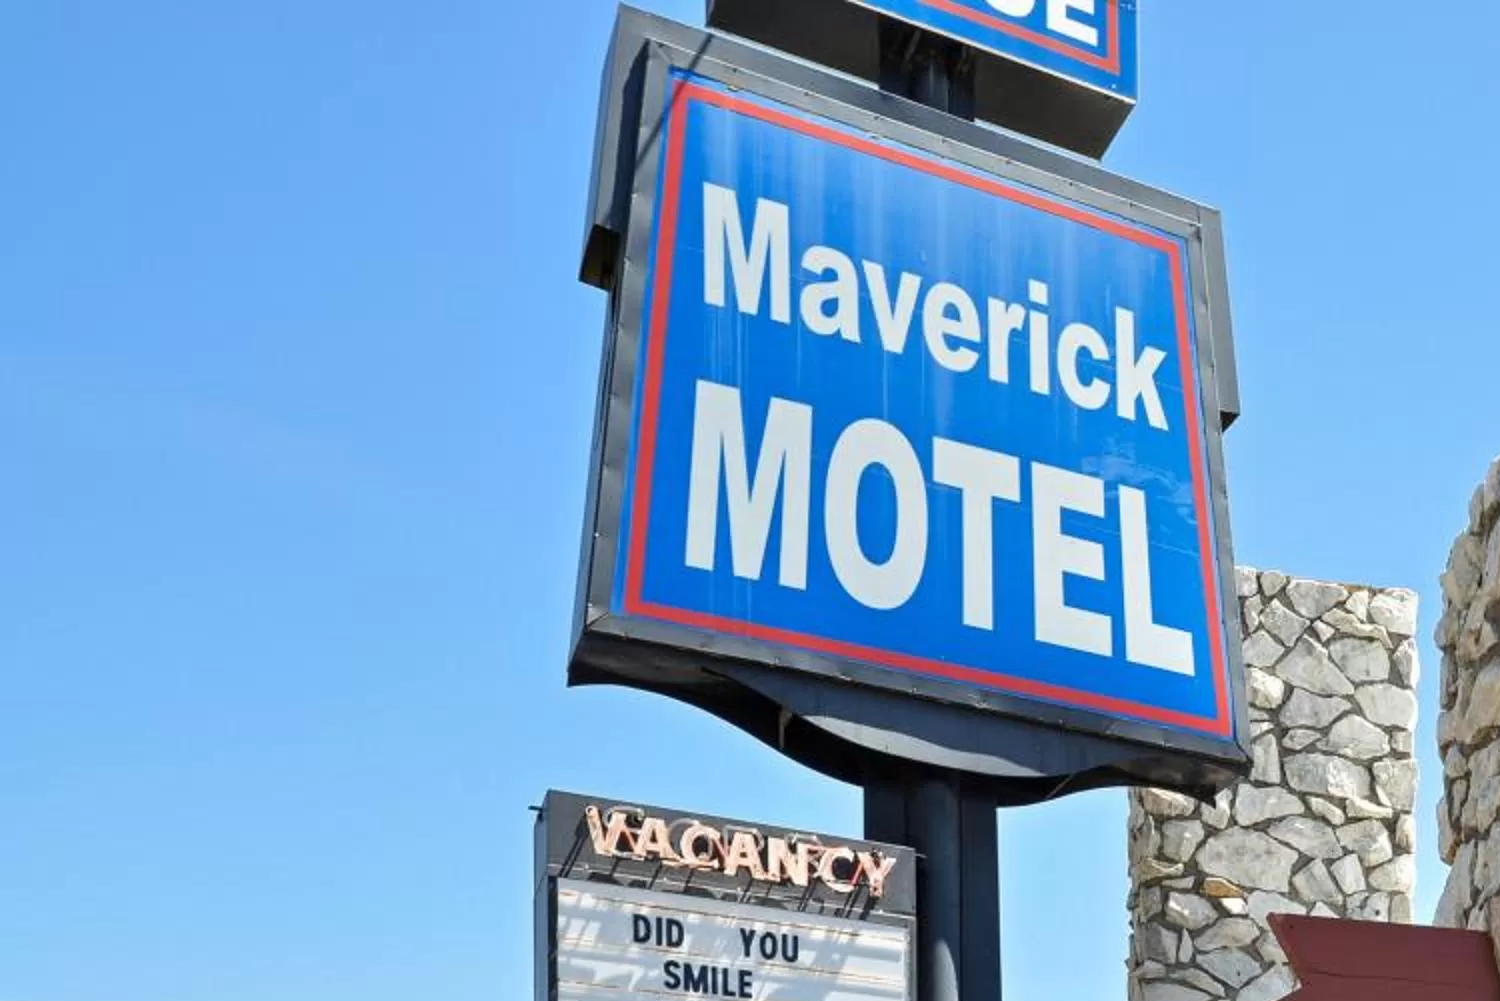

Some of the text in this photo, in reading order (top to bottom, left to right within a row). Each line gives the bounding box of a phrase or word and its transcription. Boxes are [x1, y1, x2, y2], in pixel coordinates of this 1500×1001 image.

[703, 182, 1168, 432] Maverick
[685, 380, 1195, 677] MOTEL
[585, 805, 896, 897] VACANCY
[632, 914, 799, 962] DID YOU
[663, 960, 753, 998] SMILE
